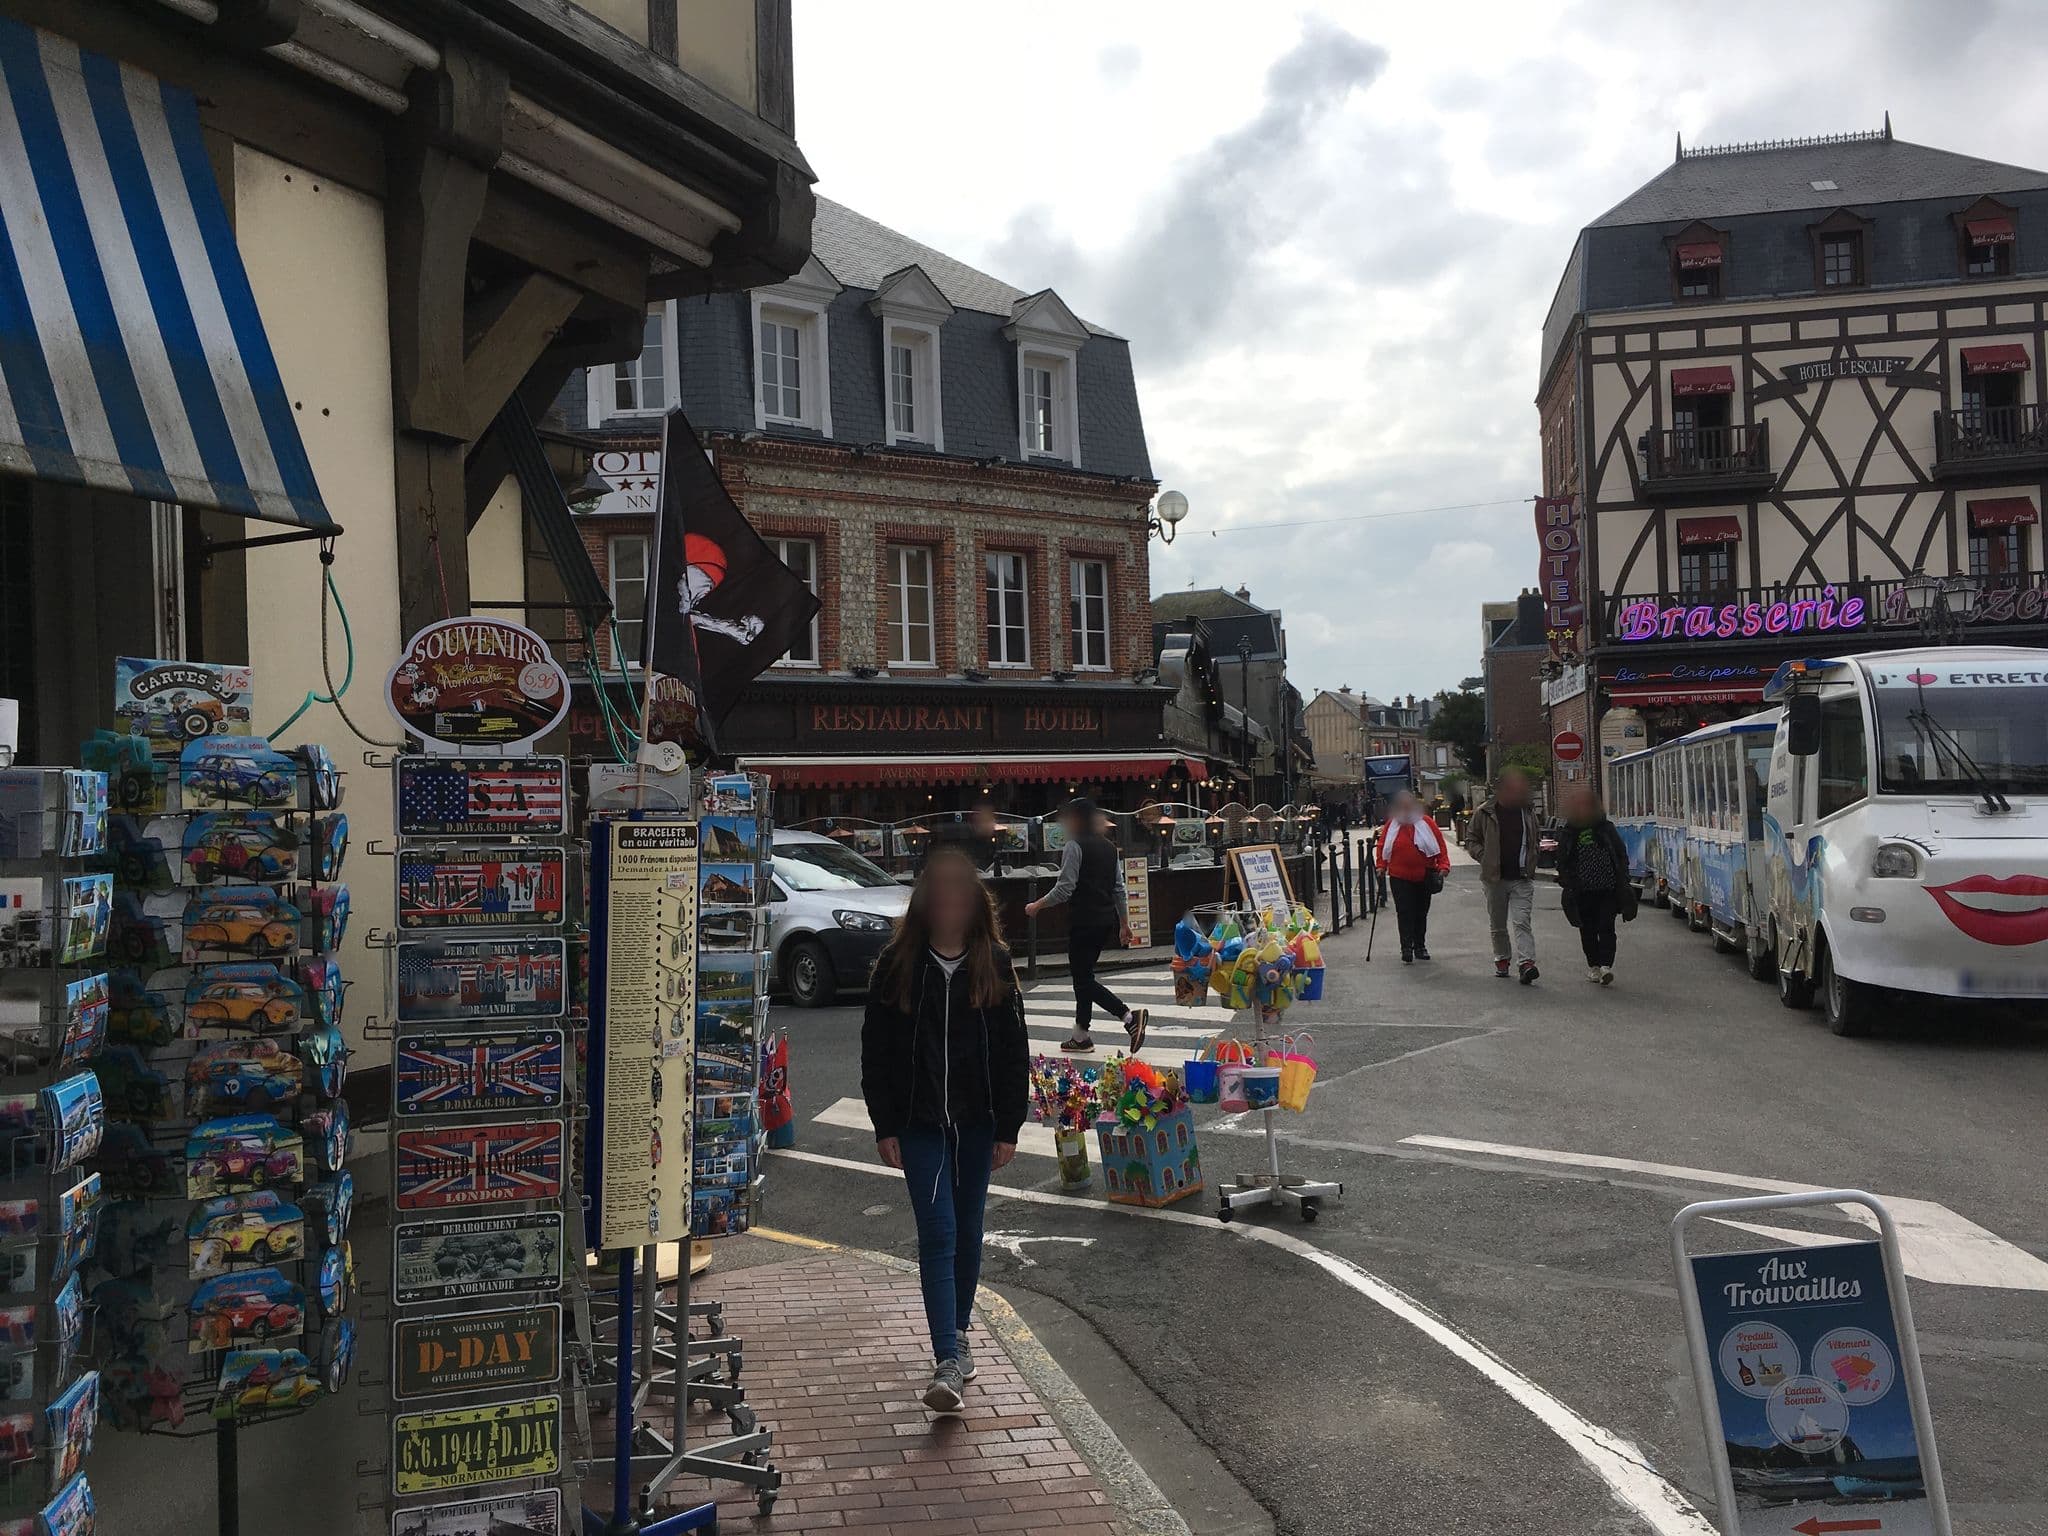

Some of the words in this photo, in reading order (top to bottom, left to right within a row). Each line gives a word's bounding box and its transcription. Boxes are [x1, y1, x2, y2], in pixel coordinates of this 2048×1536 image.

[1799, 363, 1835, 380] HOTEL
[626, 495, 651, 508] NN
[1546, 505, 1571, 627] HOTEL
[1619, 584, 1865, 641] Brasserie
[414, 625, 543, 664] SOUVENIRS
[461, 656, 476, 673] de
[136, 670, 208, 694] CARTES
[437, 666, 504, 690] Normandie
[1648, 694, 1674, 704] HOTEL
[1691, 692, 1736, 702] BRASSERIE
[812, 703, 991, 731] RESTAURANT
[1023, 704, 1099, 732] HOTEL
[879, 767, 929, 780] TAVERNE
[935, 767, 956, 778] DES
[961, 767, 990, 777] DEUX
[992, 765, 1050, 777] AUGUSTINS
[633, 827, 686, 837] BRACELETS
[622, 839, 634, 847] en
[637, 838, 658, 847] cuir
[660, 837, 695, 847] véritable
[618, 855, 638, 864] 1000
[447, 914, 460, 924] EN
[462, 912, 518, 924] NORMANDIE
[445, 1188, 514, 1203] LONDON
[442, 1219, 518, 1234] DEBARQUEMENT
[1757, 1257, 1807, 1285] Aux
[444, 1285, 457, 1296] EN
[459, 1279, 515, 1294] NORMANDIE
[1723, 1276, 1862, 1307] Trouvailles
[452, 1321, 506, 1334] NORMANDY
[1736, 1331, 1774, 1341] Produits
[417, 1330, 538, 1374] D-DAY
[1736, 1342, 1778, 1353] régionaux
[1827, 1339, 1871, 1350] Vêtements
[432, 1369, 484, 1384] OVERLORD
[486, 1365, 527, 1378] MEMORY
[1784, 1386, 1823, 1396] Cadeaux
[1784, 1396, 1827, 1406] Souvenirs
[501, 1419, 554, 1457] D.DAY
[440, 1466, 515, 1486] NORMANDIE
